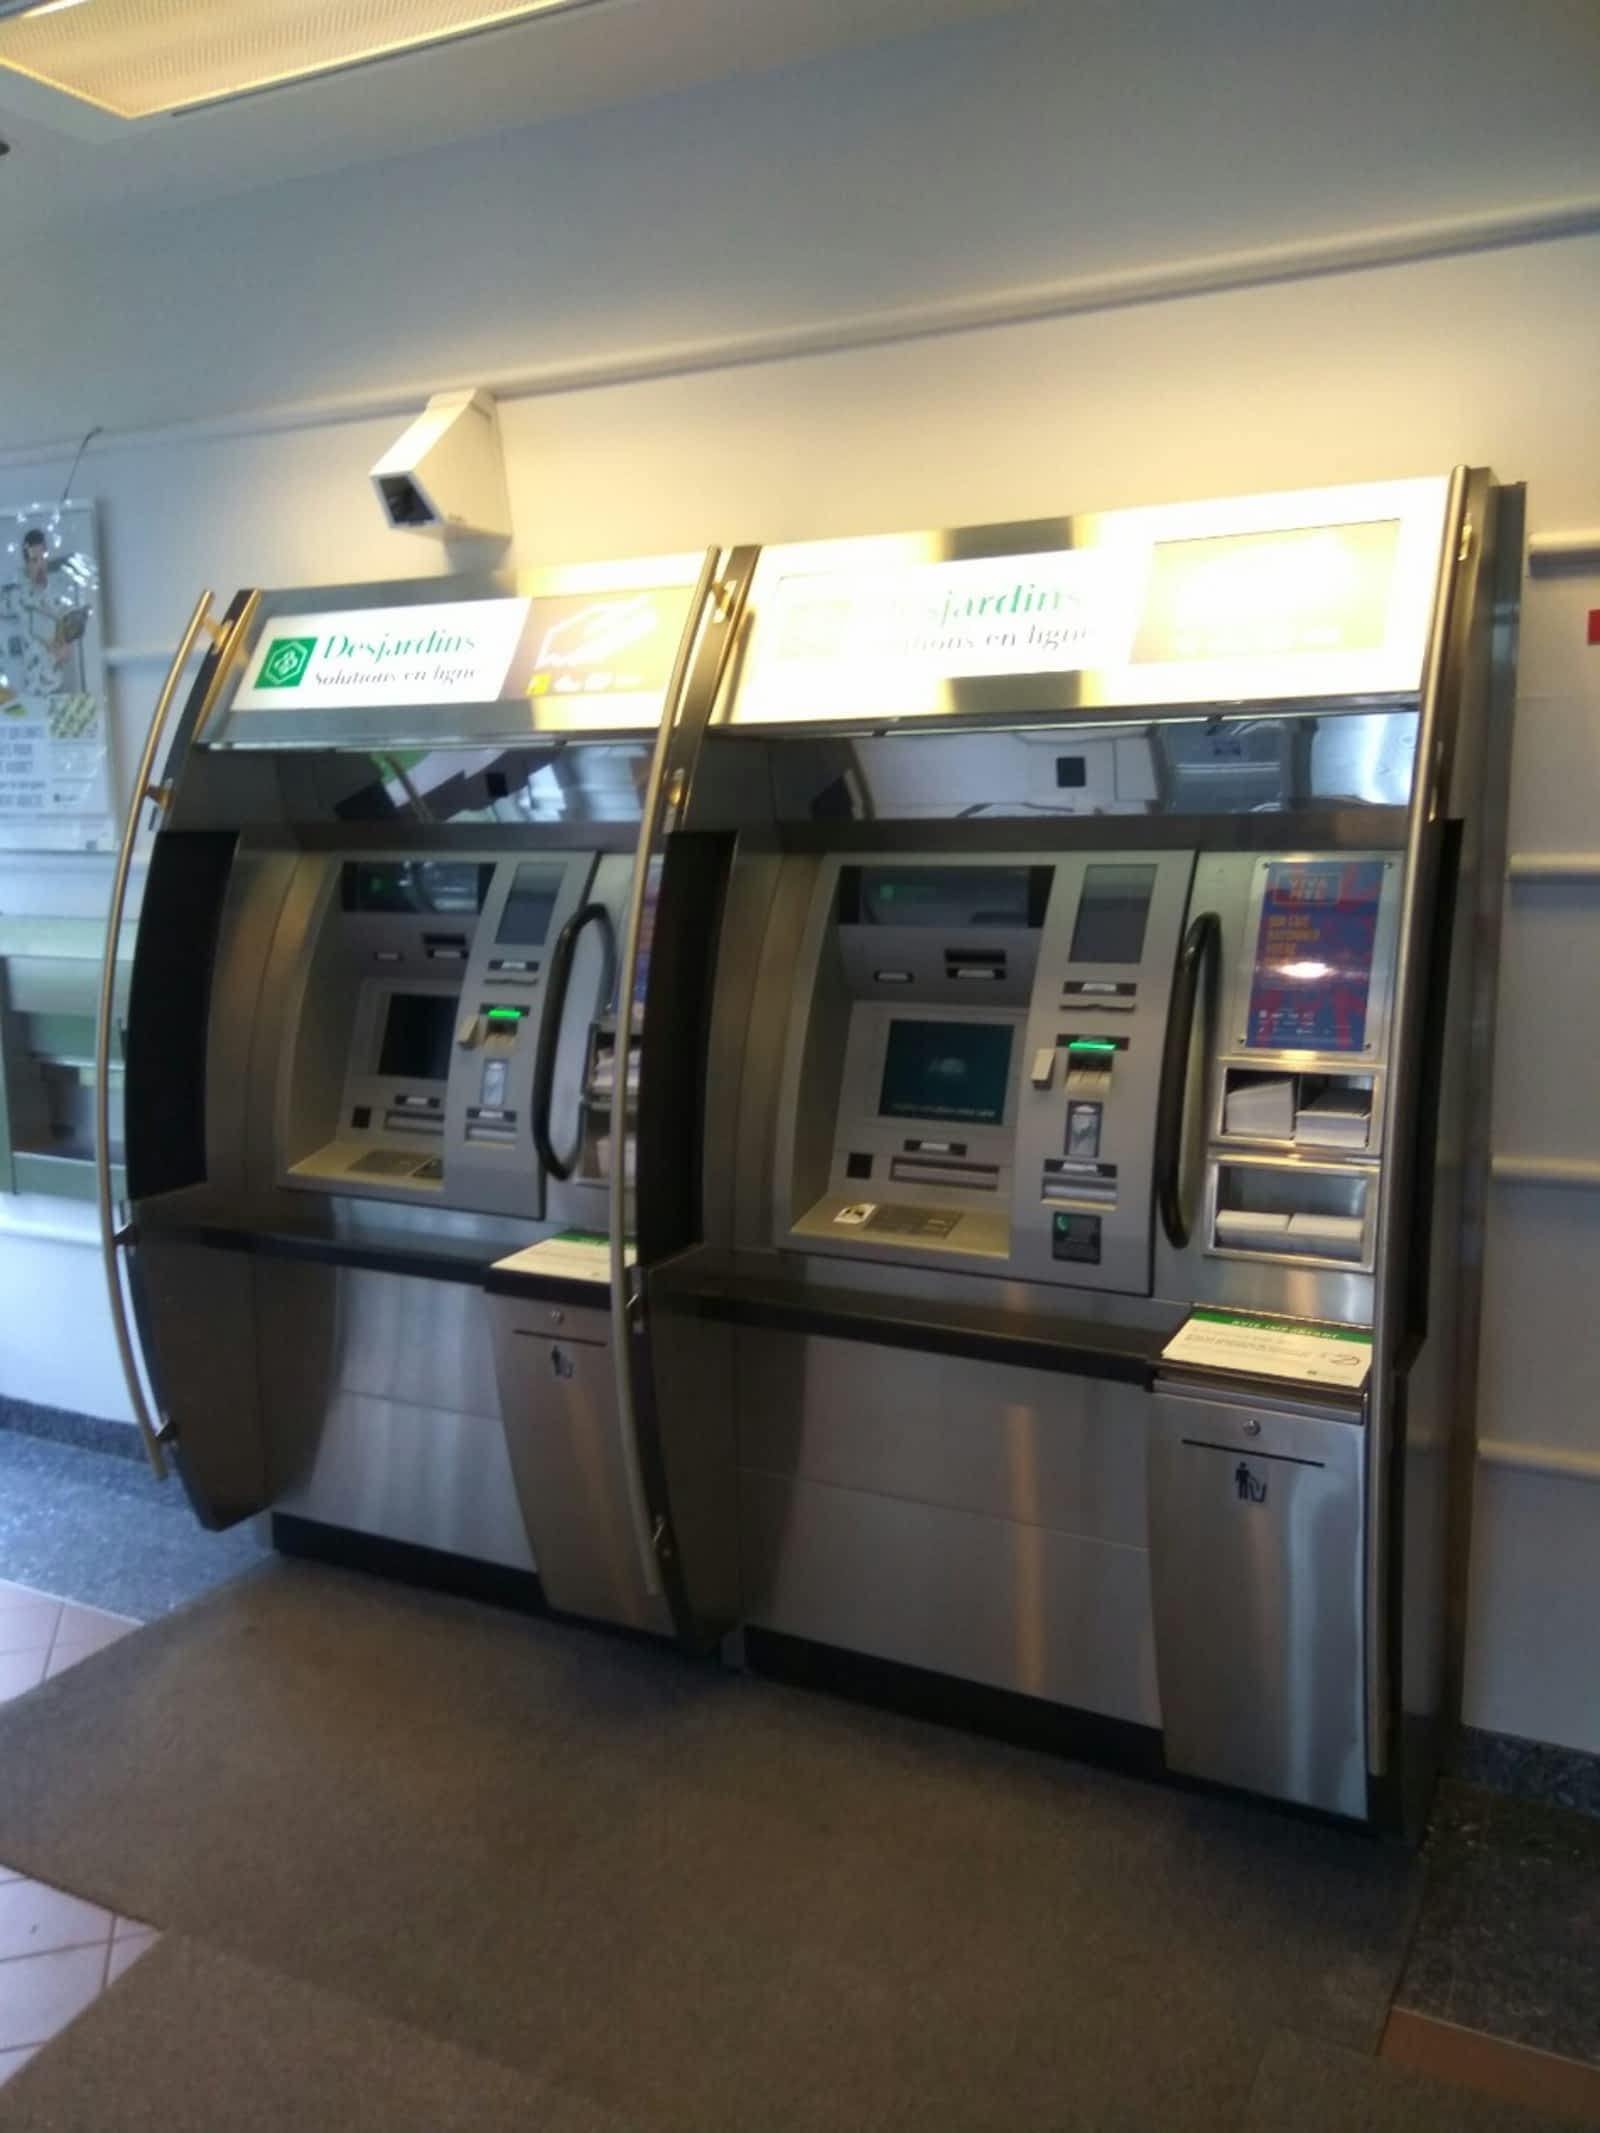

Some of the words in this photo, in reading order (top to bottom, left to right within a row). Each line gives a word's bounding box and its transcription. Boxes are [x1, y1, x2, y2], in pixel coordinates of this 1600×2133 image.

[322, 629, 476, 665] Desjardins
[985, 632, 1017, 647] en
[314, 669, 397, 686] Solutions
[403, 670, 427, 681] en
[432, 664, 476, 685] ligne
